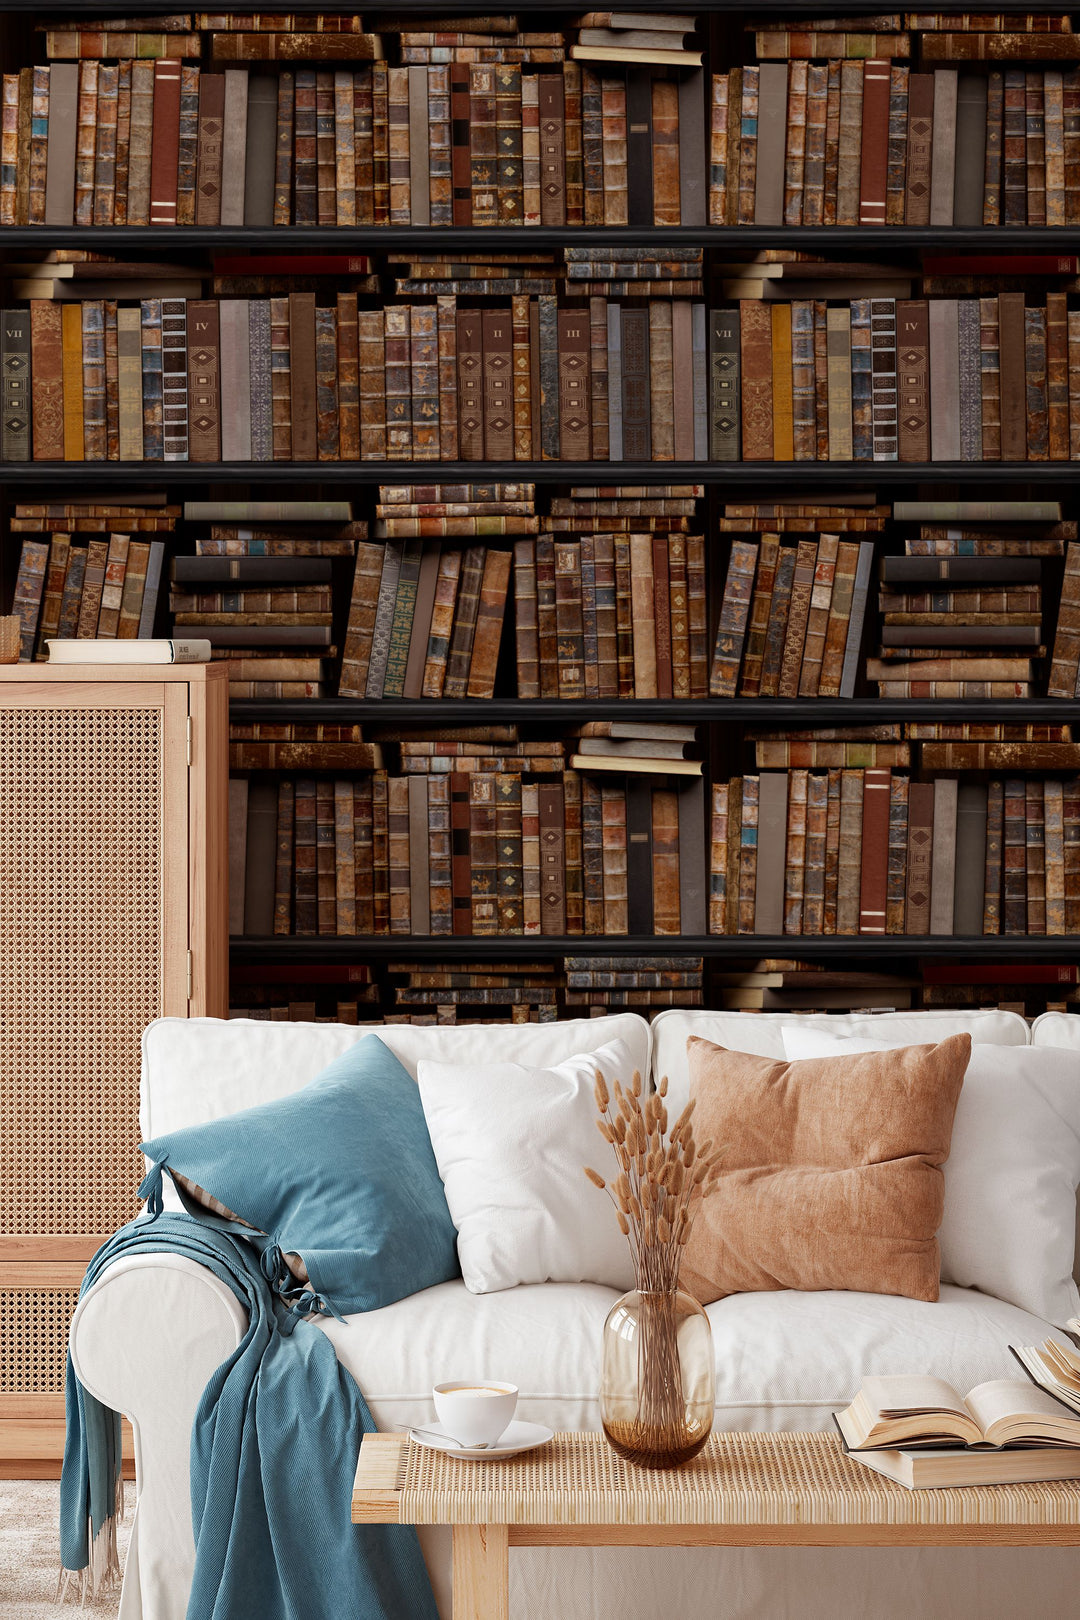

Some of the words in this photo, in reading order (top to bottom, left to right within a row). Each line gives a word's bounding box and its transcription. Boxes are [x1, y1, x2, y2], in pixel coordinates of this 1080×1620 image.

[195, 322, 209, 330] IV
[905, 322, 918, 331] IV
[716, 330, 732, 338] VII
